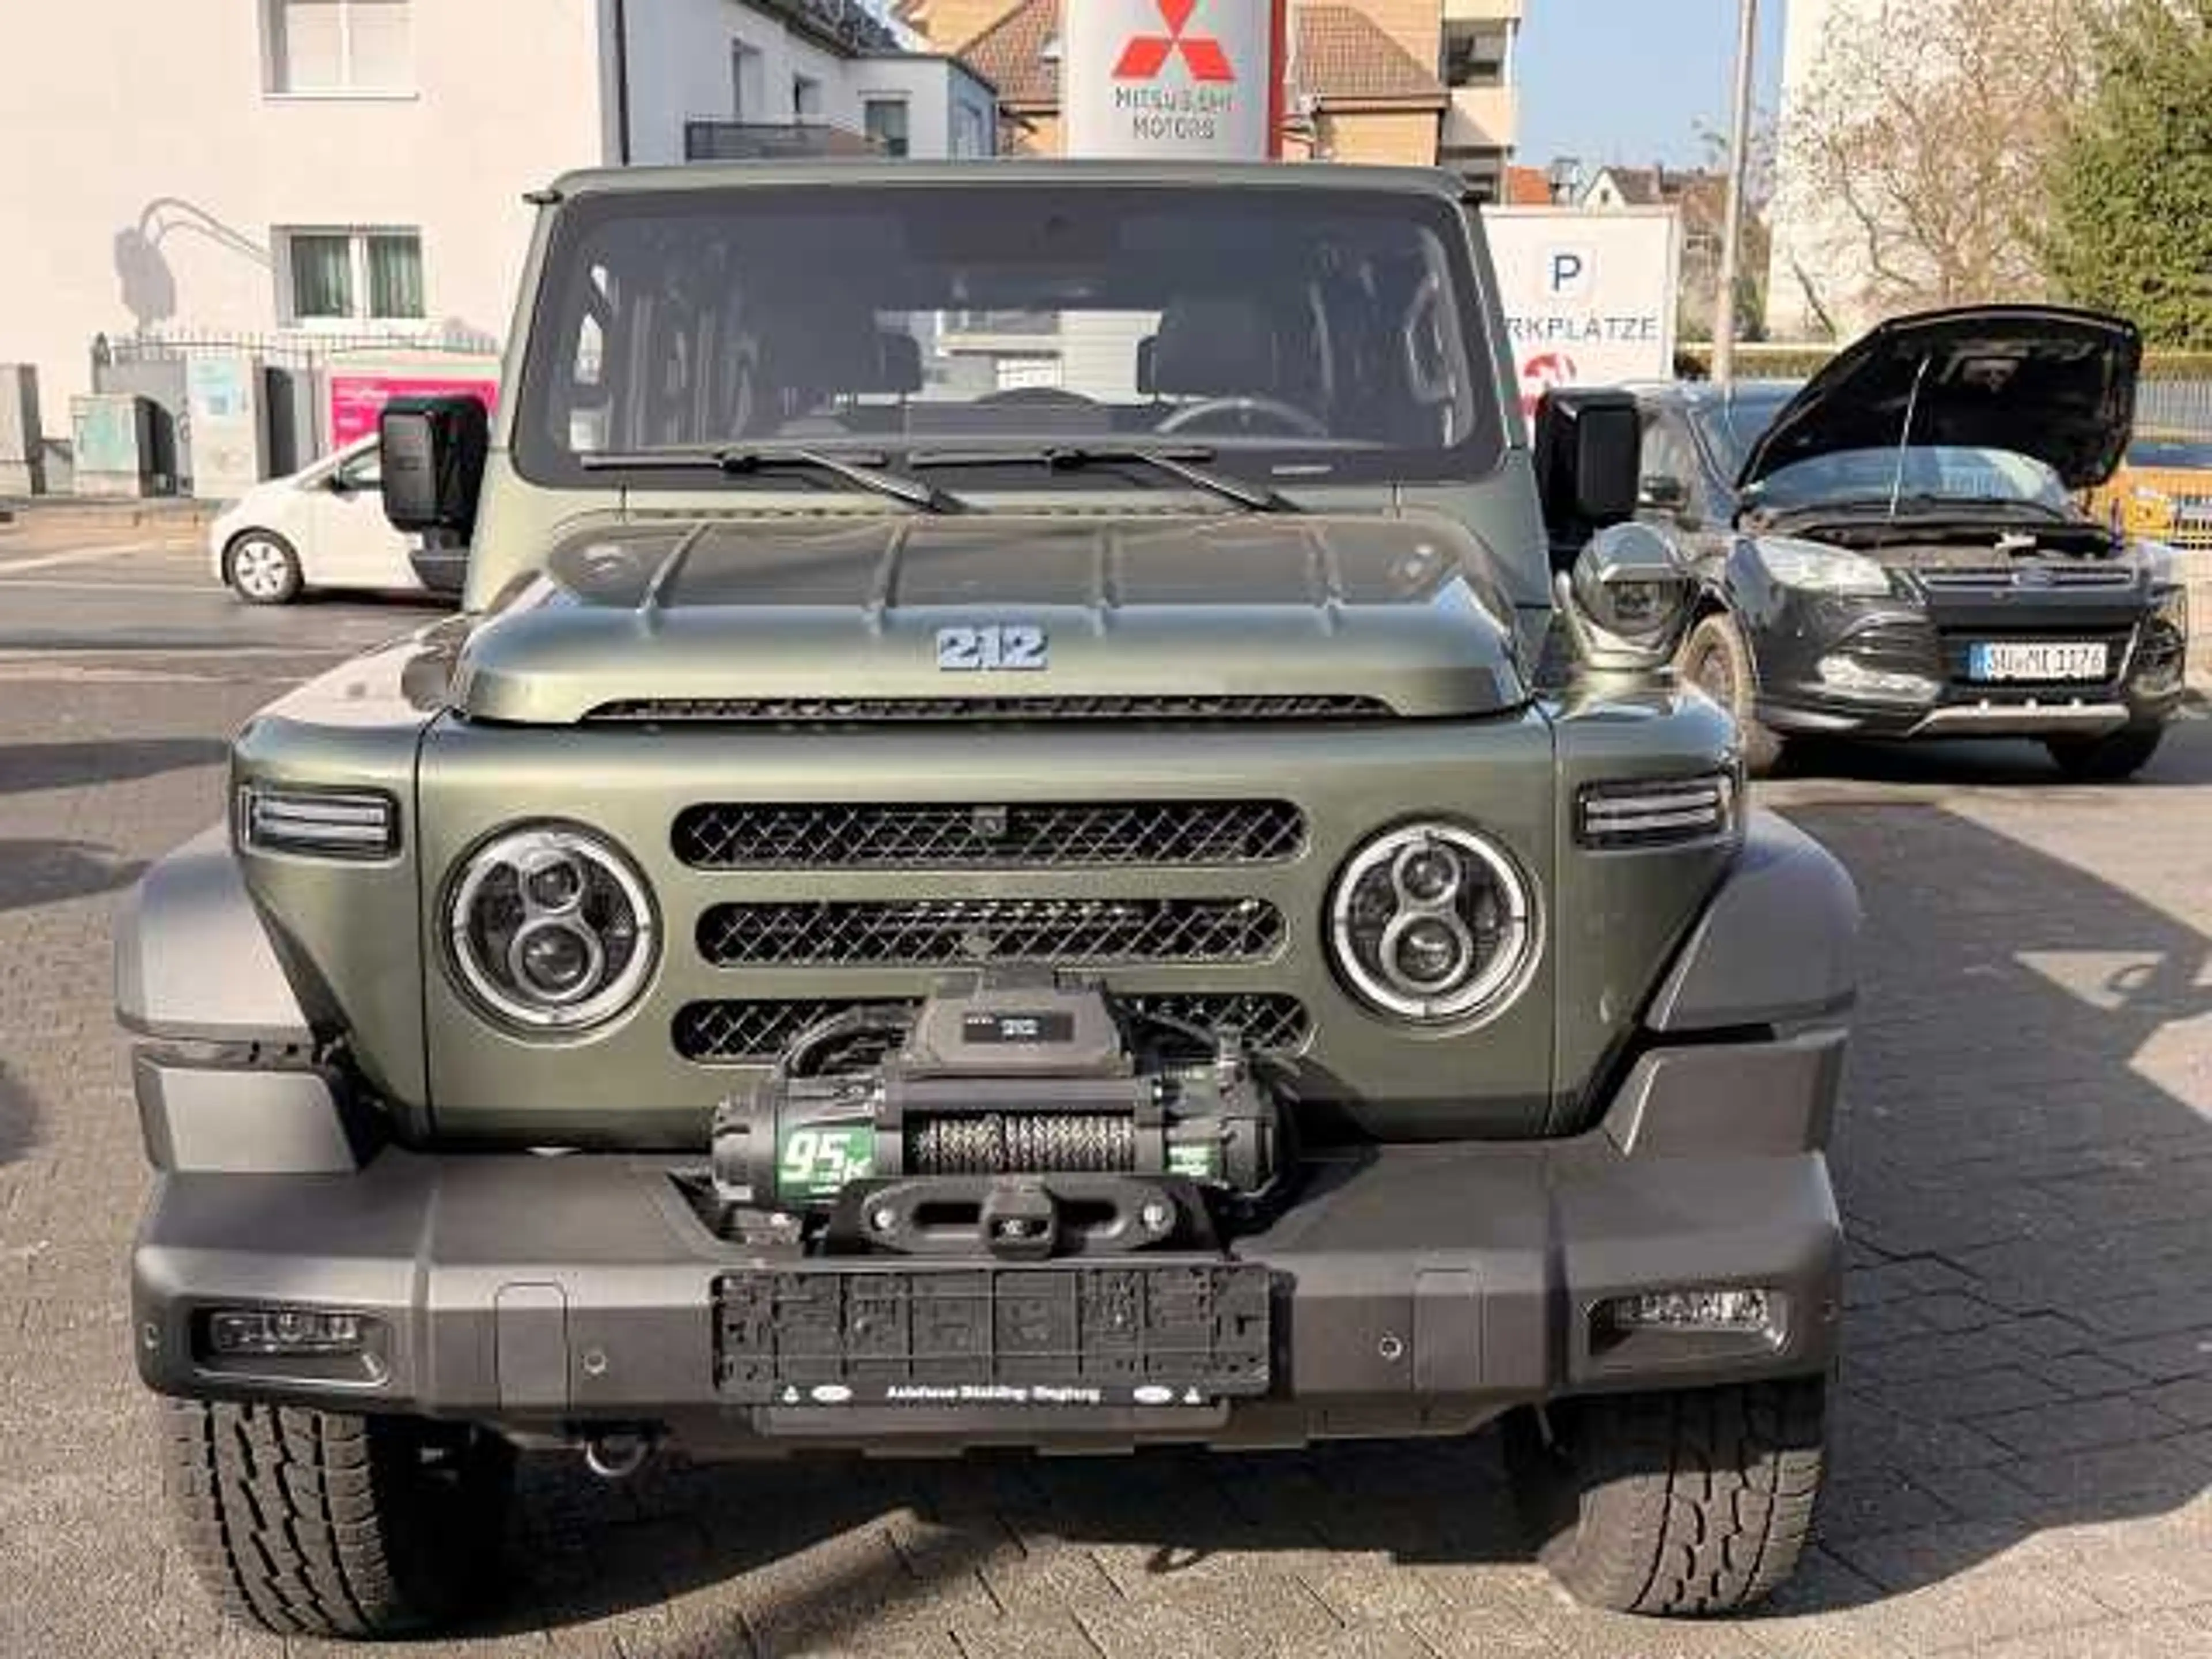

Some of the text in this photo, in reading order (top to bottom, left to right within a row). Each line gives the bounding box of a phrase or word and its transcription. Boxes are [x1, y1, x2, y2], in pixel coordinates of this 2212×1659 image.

[1132, 116, 1215, 139] MOTORS
[1552, 255, 1581, 291] P
[937, 627, 1047, 671] 212
